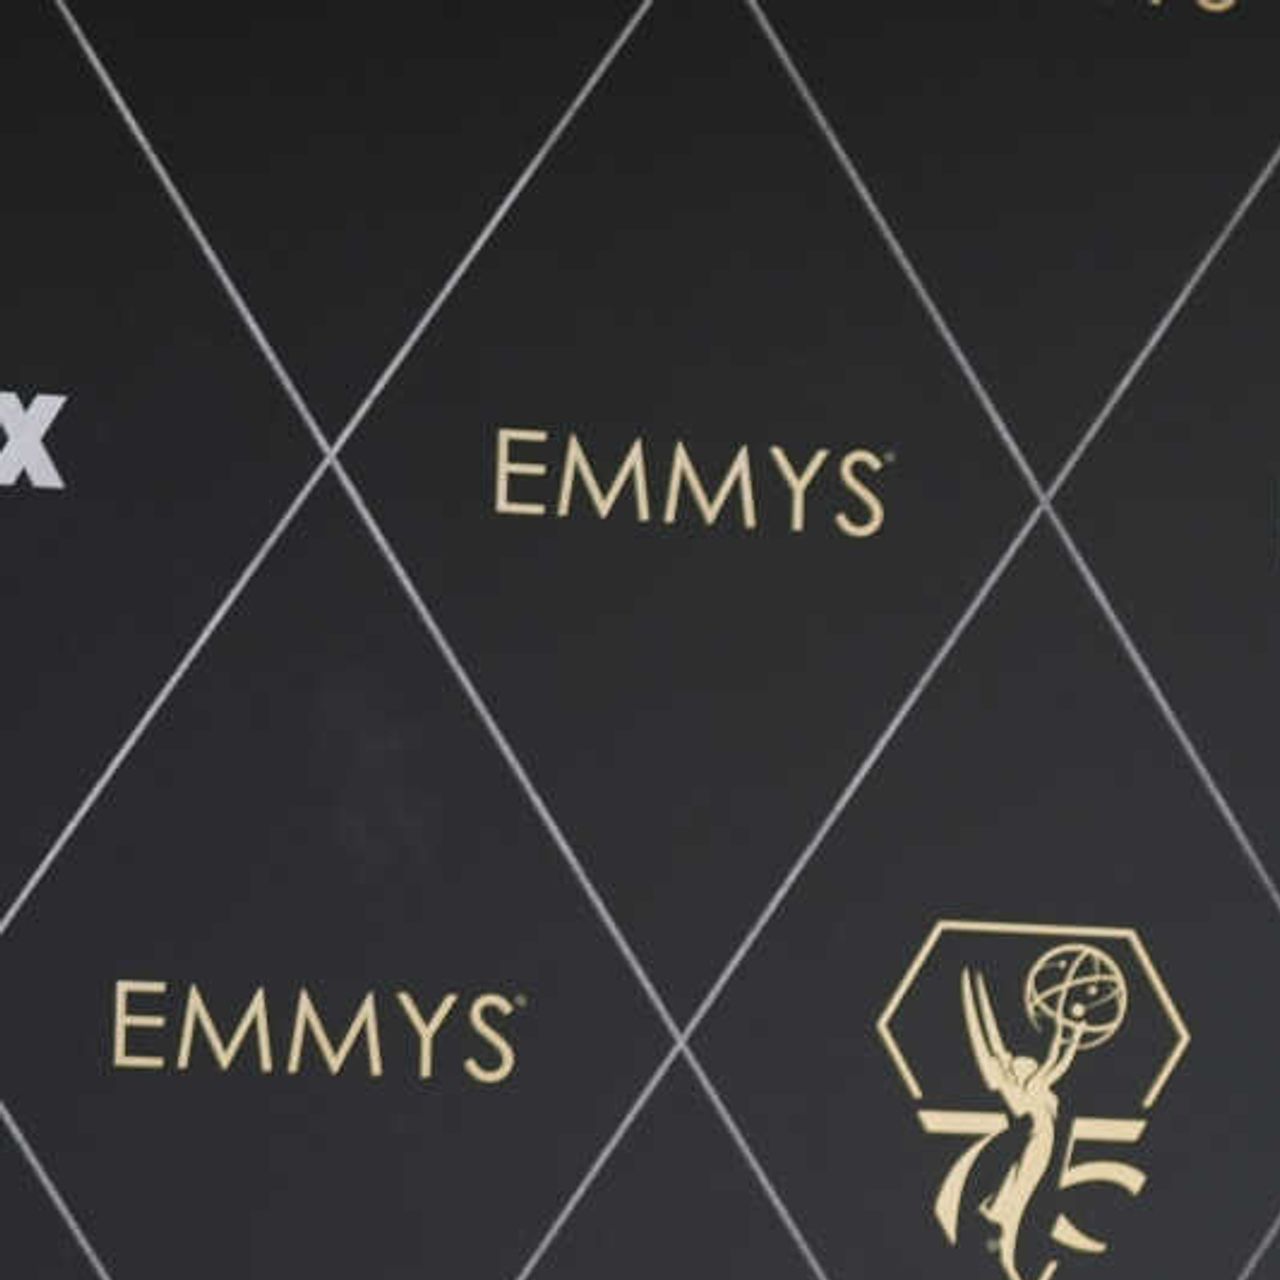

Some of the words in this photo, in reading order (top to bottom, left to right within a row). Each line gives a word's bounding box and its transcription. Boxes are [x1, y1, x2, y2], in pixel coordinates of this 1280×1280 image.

[494, 427, 885, 538] EMMYS
[113, 978, 516, 1084] EMMYS
[917, 1109, 1147, 1253] 75
